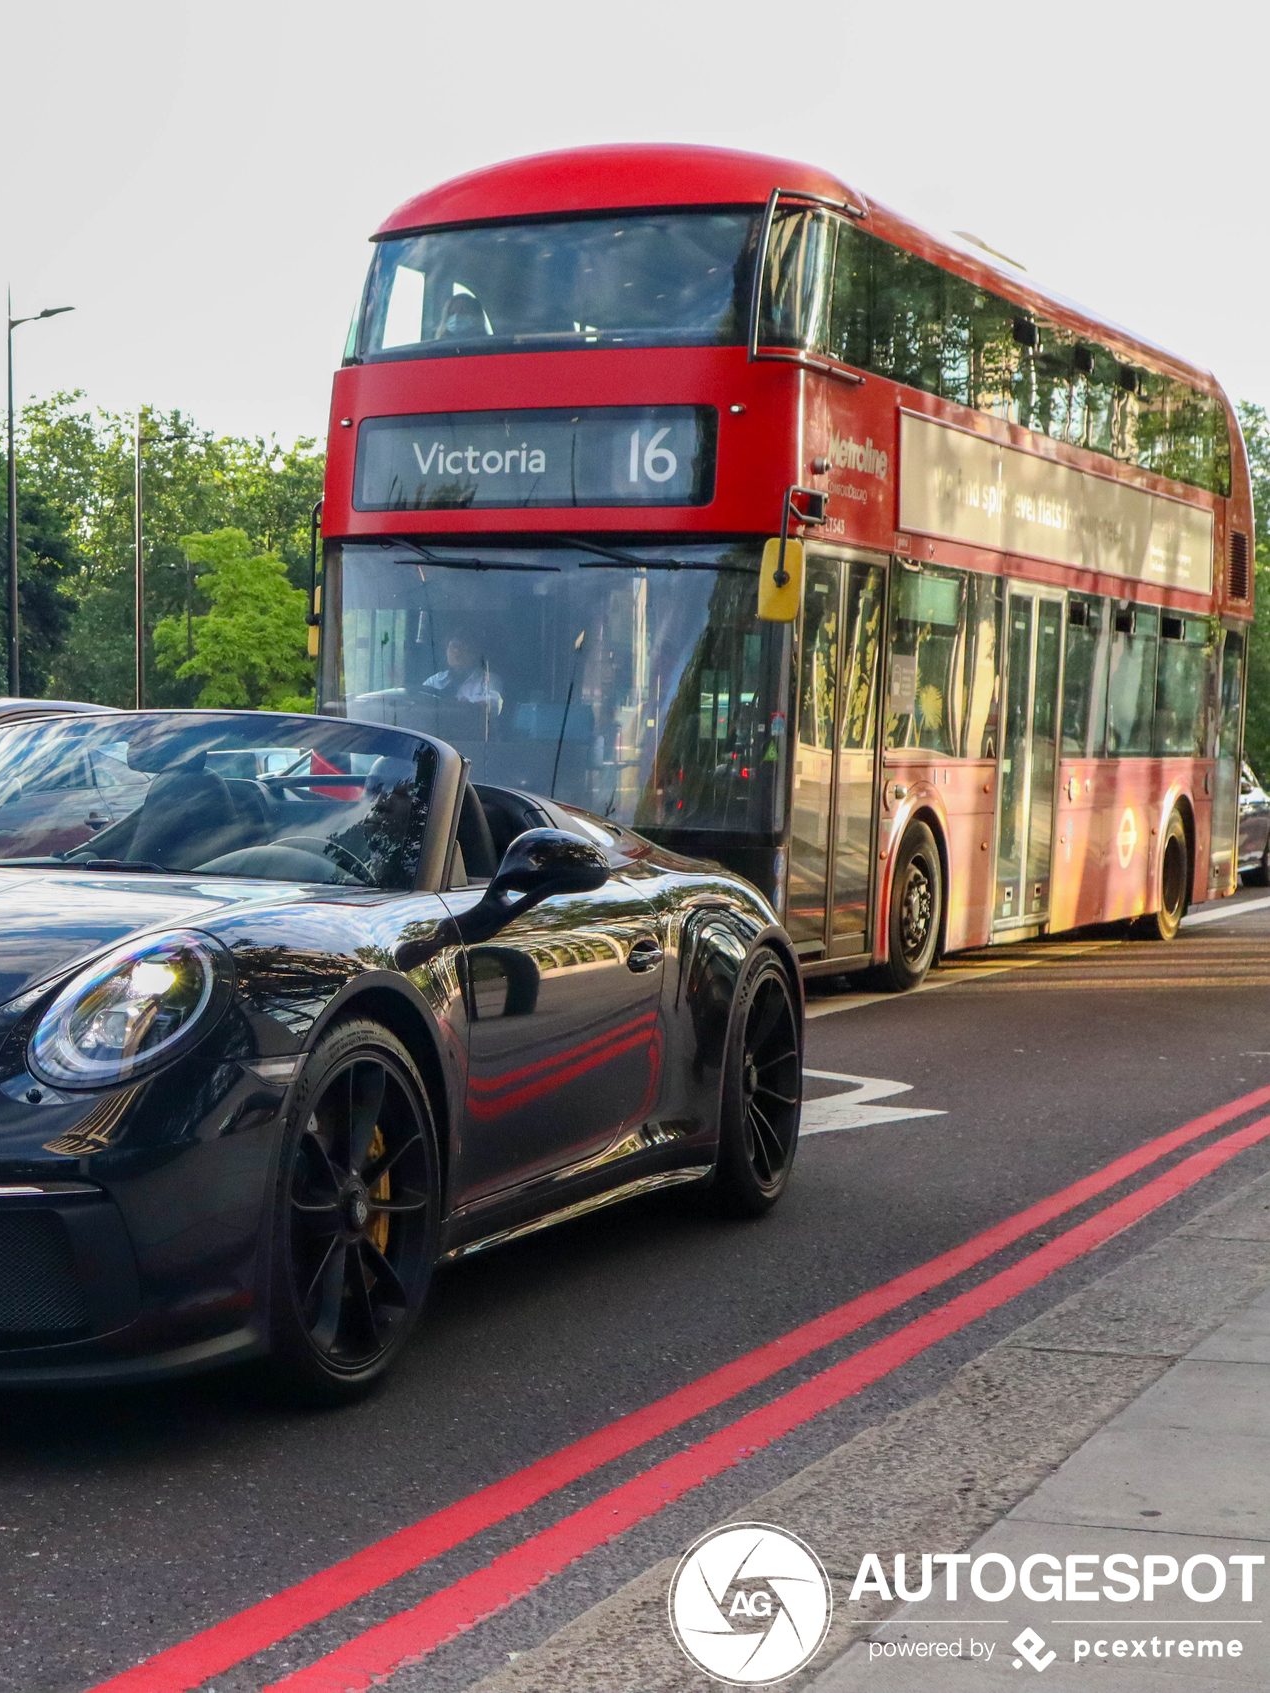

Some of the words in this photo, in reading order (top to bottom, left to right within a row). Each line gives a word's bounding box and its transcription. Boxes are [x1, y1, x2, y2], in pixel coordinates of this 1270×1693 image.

[413, 442, 546, 476] Victoria
[629, 427, 678, 483] 16
[829, 428, 888, 479] Metroline
